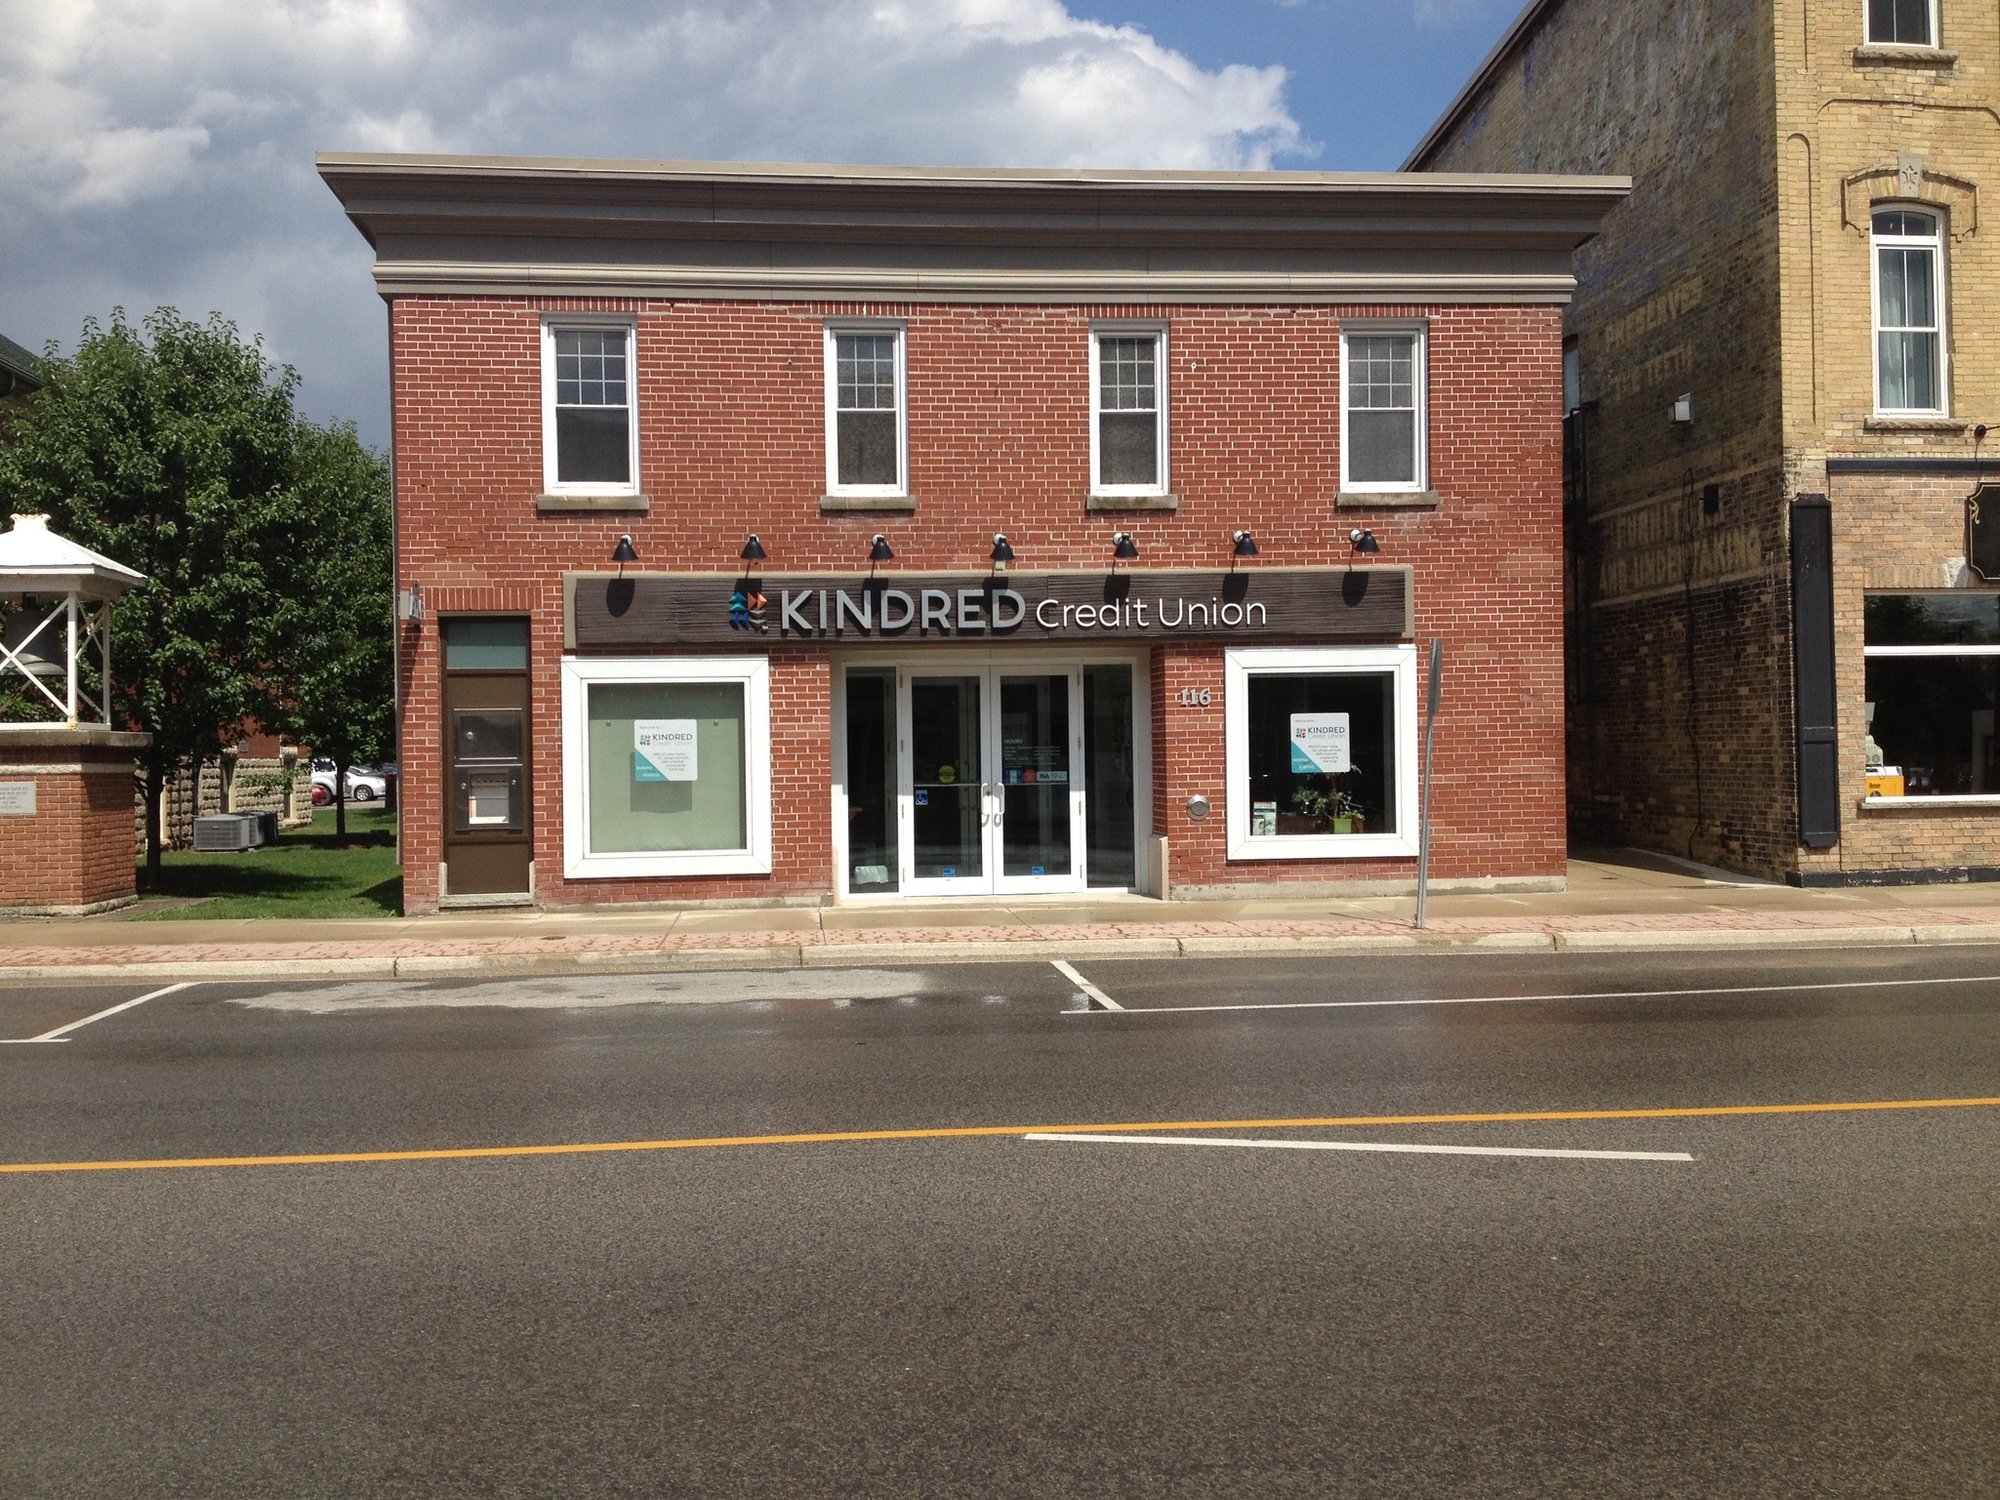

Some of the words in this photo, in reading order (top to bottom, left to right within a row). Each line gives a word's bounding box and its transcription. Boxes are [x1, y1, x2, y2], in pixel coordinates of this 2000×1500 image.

[781, 589, 1026, 630] KINDRED
[1036, 597, 1150, 628] Credit
[1159, 596, 1267, 627] Union
[1181, 687, 1212, 706] 116
[1308, 726, 1345, 734] KINDRED
[652, 733, 693, 741] KINDRED
